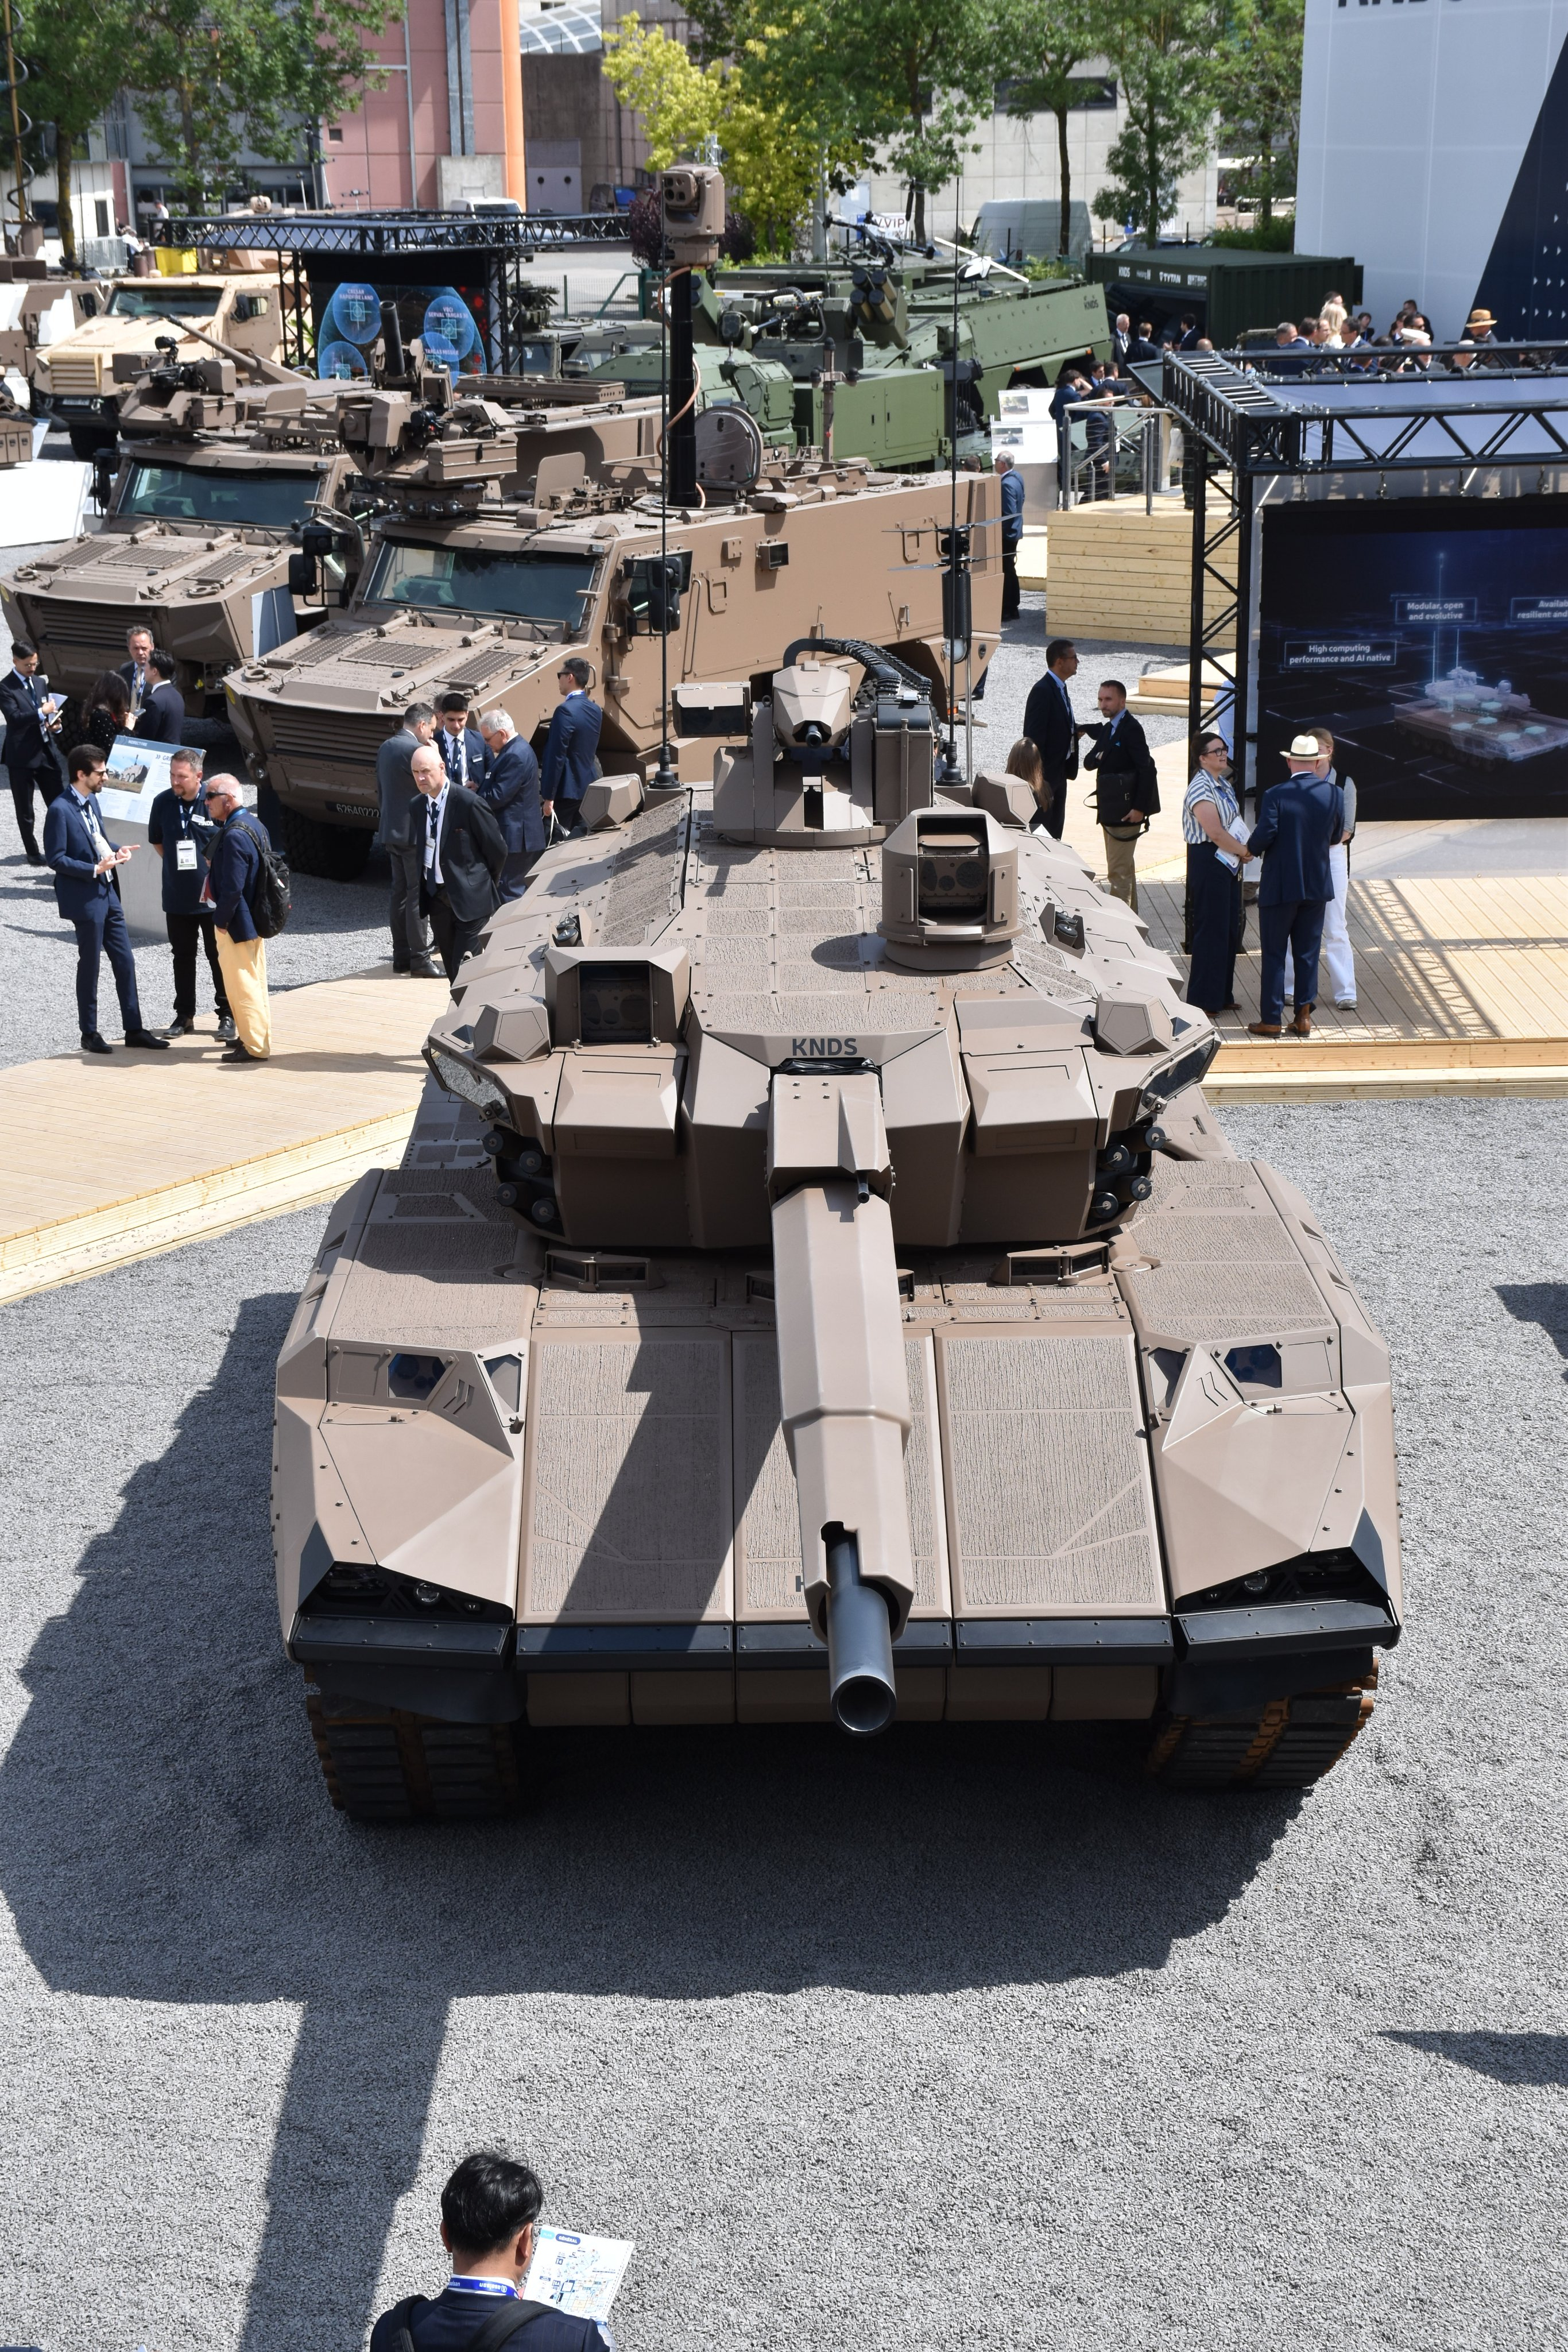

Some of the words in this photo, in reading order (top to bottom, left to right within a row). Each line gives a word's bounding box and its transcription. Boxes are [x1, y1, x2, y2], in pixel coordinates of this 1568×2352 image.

[1407, 602, 1442, 610] Modular,
[1425, 612, 1463, 620] evolutive
[1517, 610, 1551, 618] resilient
[1308, 645, 1327, 654] High
[1329, 644, 1370, 653] computing
[1290, 656, 1338, 665] performance
[792, 1038, 858, 1057] KNDS
